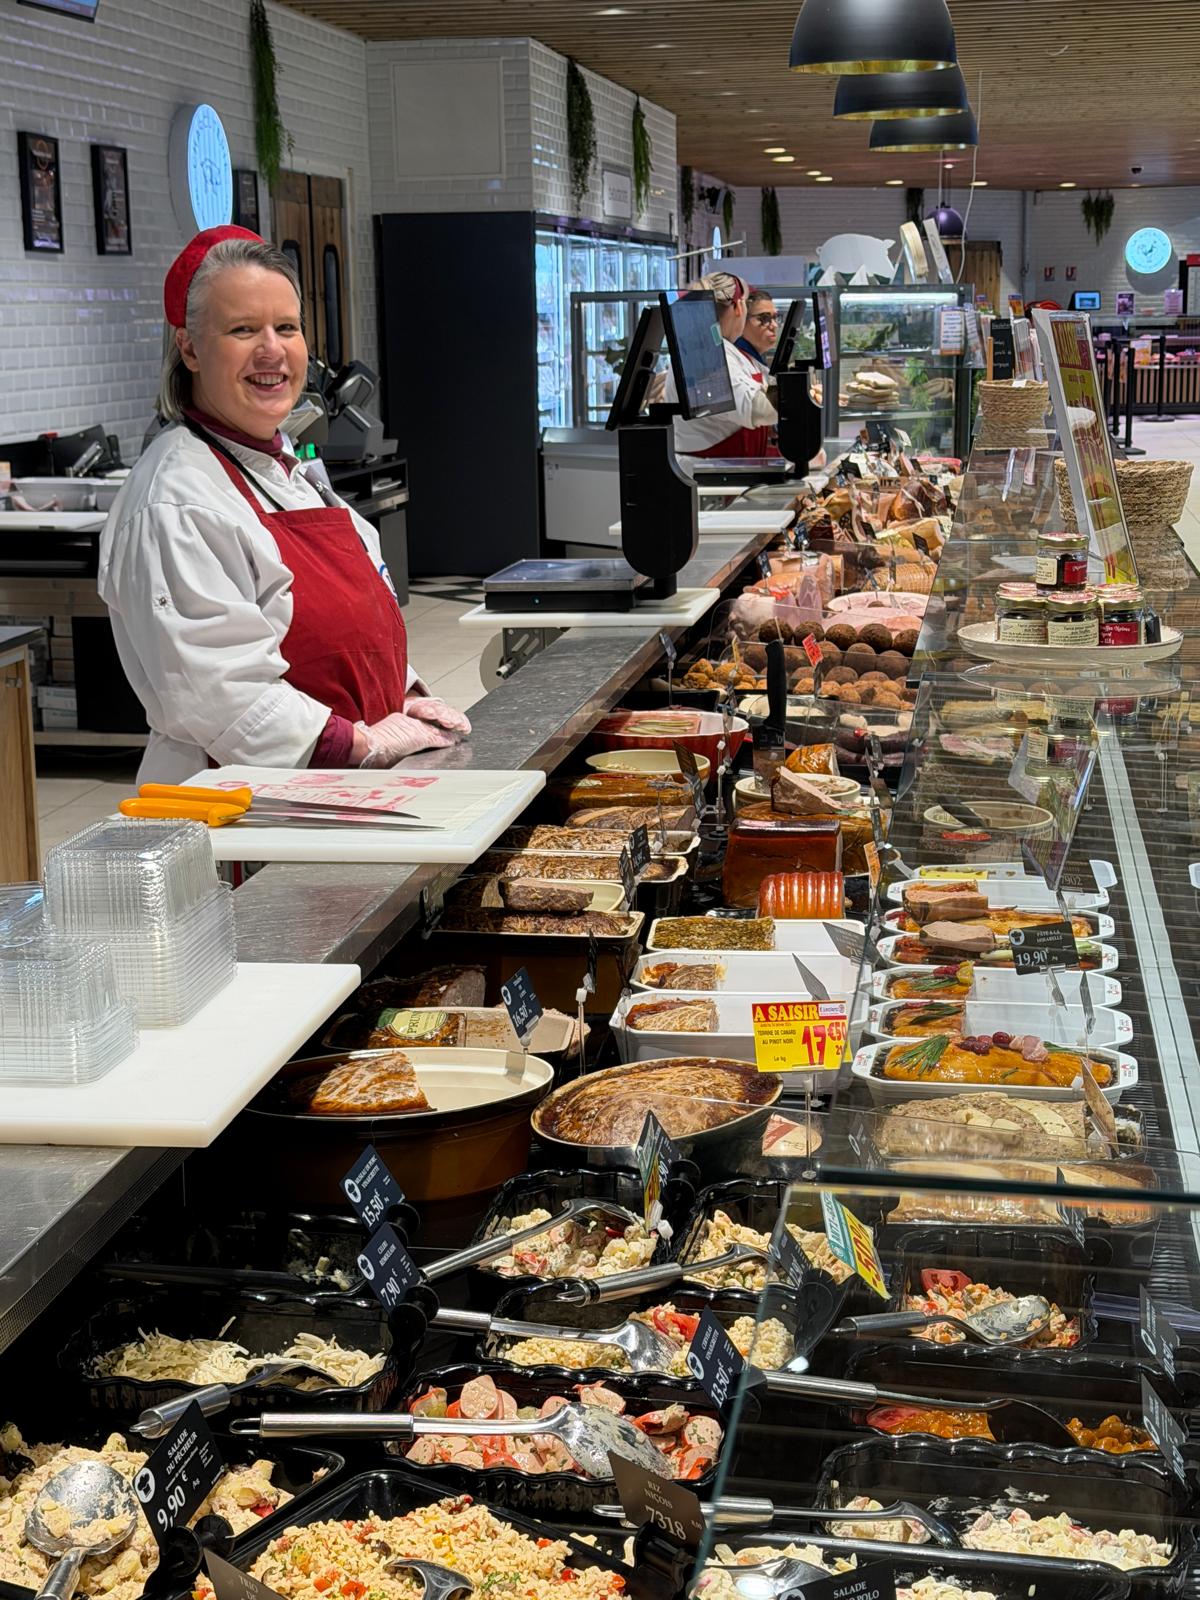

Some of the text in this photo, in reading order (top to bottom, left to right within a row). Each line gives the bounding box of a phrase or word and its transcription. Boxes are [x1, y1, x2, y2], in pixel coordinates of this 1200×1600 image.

[754, 1004, 819, 1022] A SAISIR
[802, 1025, 826, 1066] 17
[167, 1428, 189, 1459] SALADE
[166, 1460, 176, 1475] DU
[645, 1504, 686, 1540] 7318
[833, 1581, 867, 1599] SALADE
